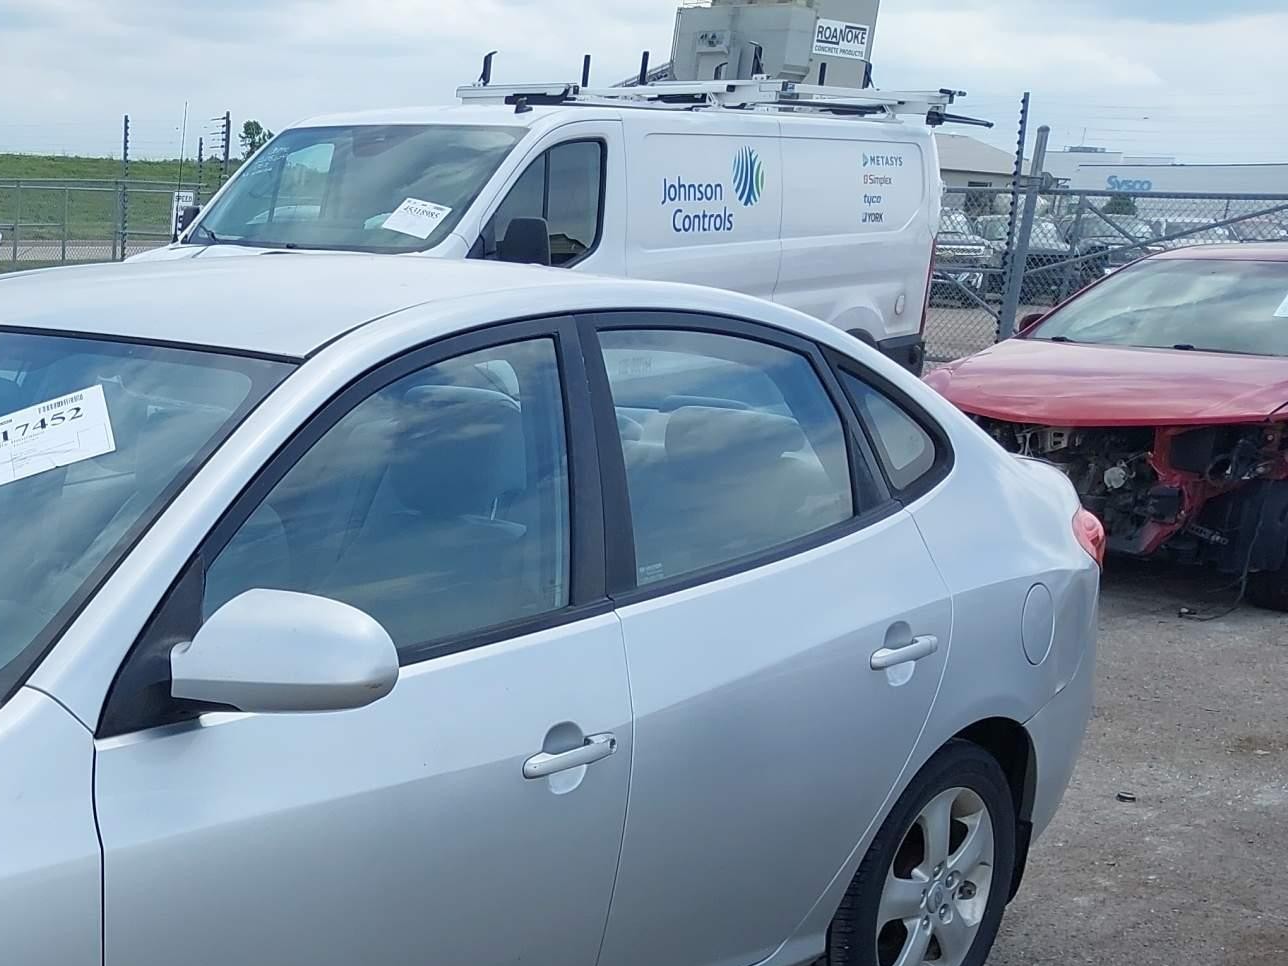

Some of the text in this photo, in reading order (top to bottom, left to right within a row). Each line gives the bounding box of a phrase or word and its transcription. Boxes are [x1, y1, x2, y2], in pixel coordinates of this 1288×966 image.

[816, 25, 867, 45] ROANOKE
[869, 155, 903, 167] METASYS
[661, 176, 723, 205] Johnson
[1105, 175, 1152, 191] Sysco
[863, 193, 882, 206] tyco
[672, 206, 733, 232] Controls
[868, 212, 883, 222] YORK
